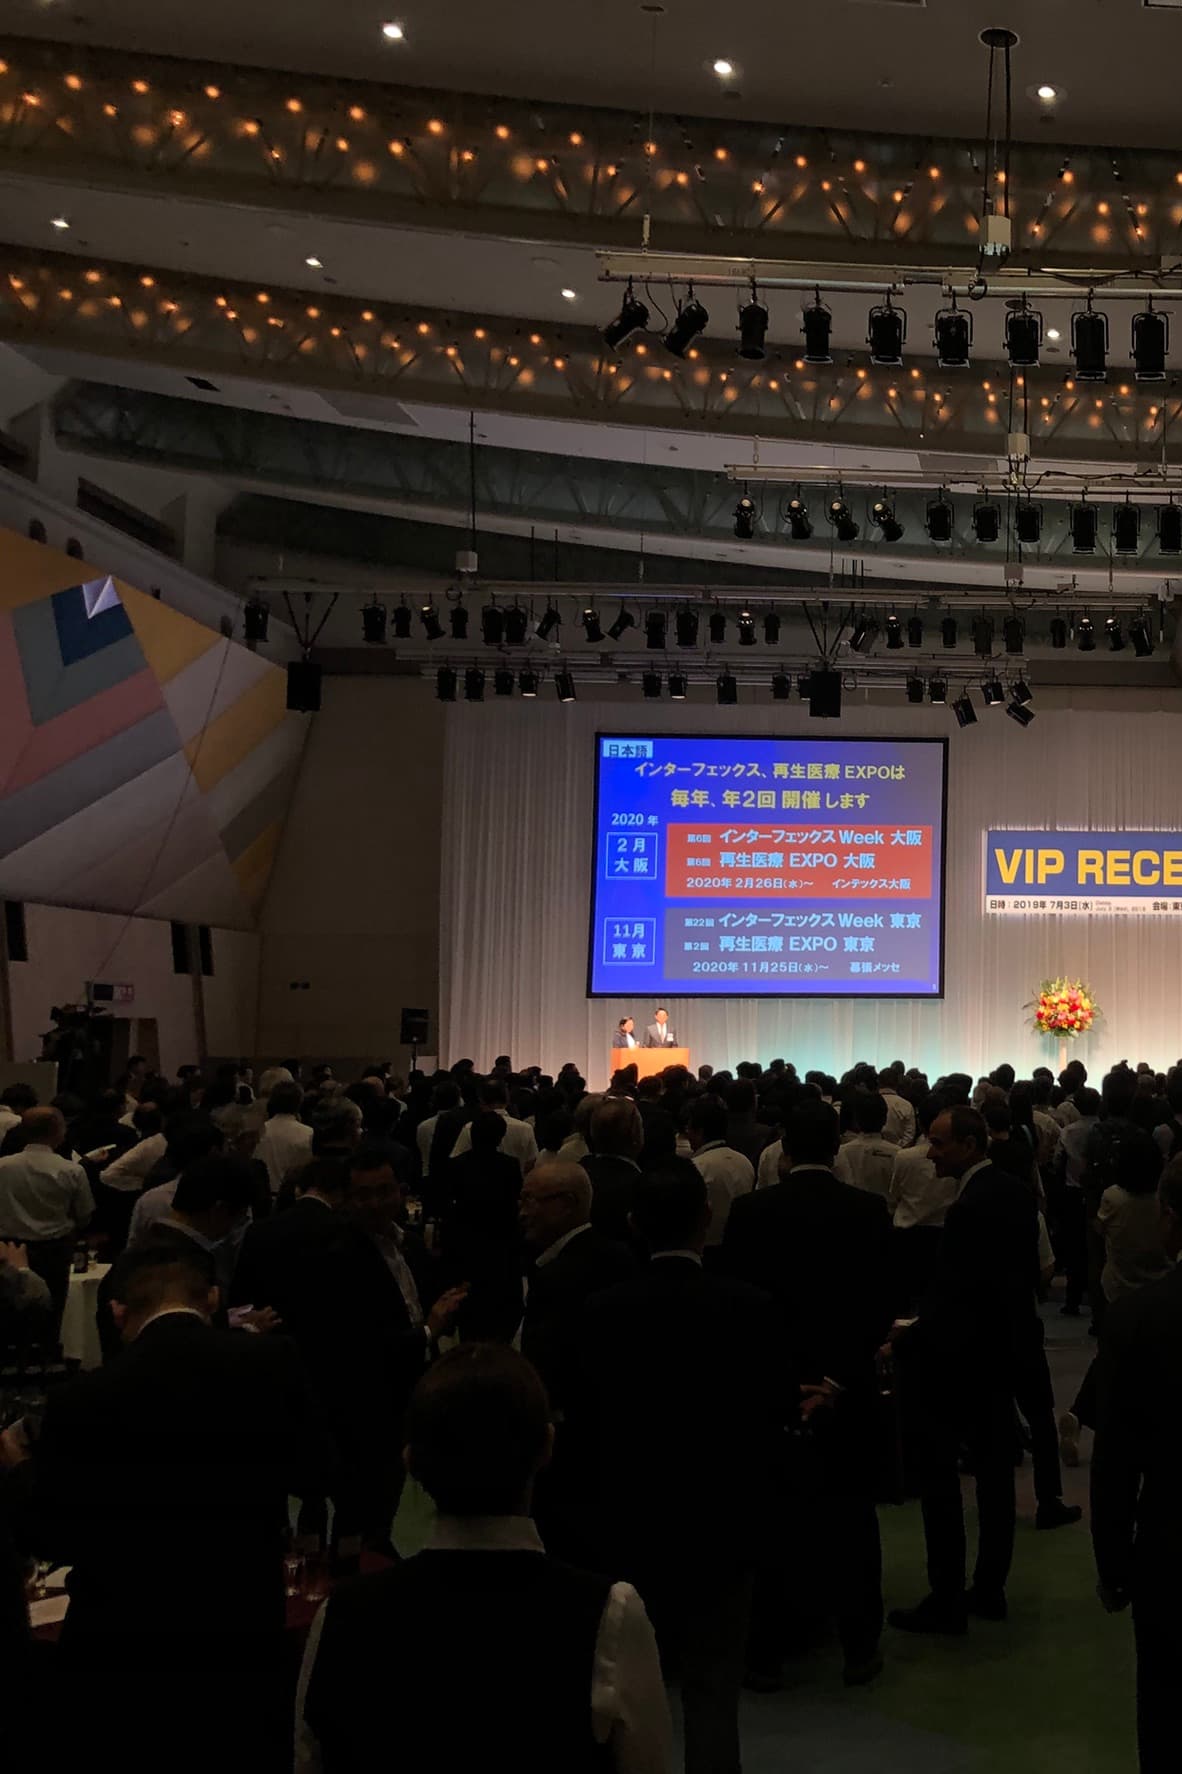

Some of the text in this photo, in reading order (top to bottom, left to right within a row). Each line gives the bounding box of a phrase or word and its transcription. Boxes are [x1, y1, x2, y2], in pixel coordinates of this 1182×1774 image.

[609, 744, 648, 758] 日本語
[611, 813, 644, 826] 2020
[890, 830, 922, 846] 大阪
[720, 852, 784, 868] 再生医療
[789, 853, 838, 868] EXPO
[844, 853, 876, 869] 大阪
[994, 848, 1065, 885] VIP
[890, 912, 922, 929] 東京
[719, 936, 784, 952] 再生医療
[789, 936, 838, 952] EXPO
[843, 936, 876, 952] 東京
